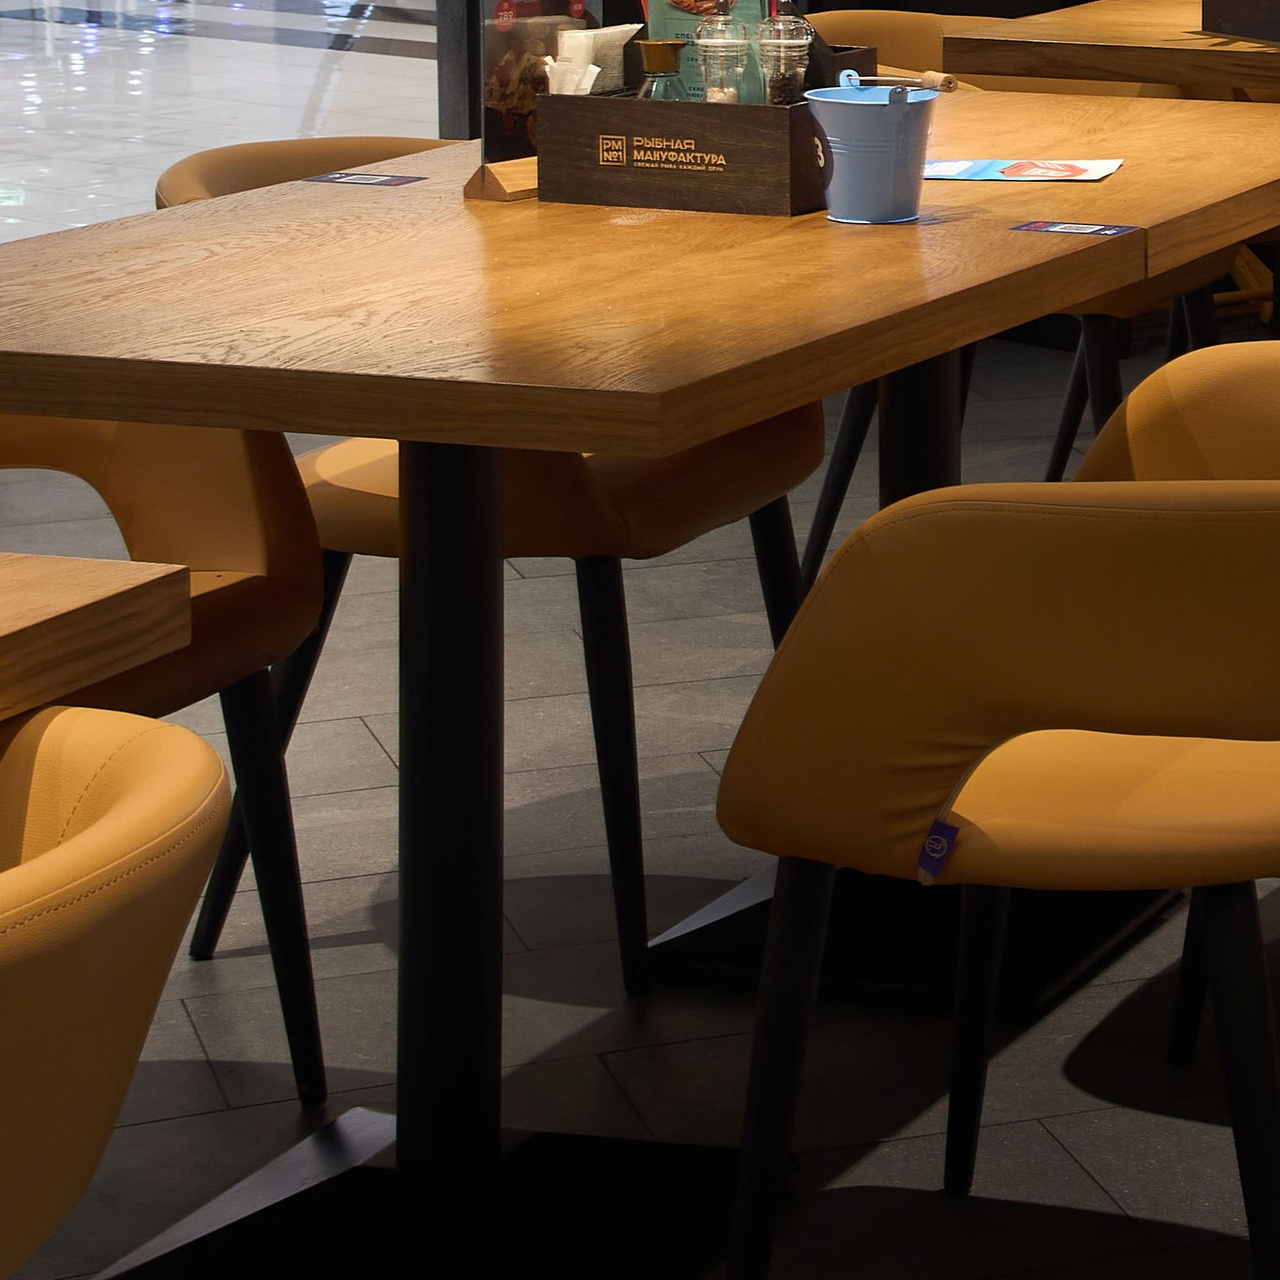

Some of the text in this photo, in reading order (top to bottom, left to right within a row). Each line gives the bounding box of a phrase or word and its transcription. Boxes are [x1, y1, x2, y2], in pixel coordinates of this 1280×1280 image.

[603, 139, 623, 150] РМ
[633, 136, 695, 150] РЫБНАЯ
[603, 150, 623, 161] №1
[633, 149, 727, 166] МАНУФАКТУРА
